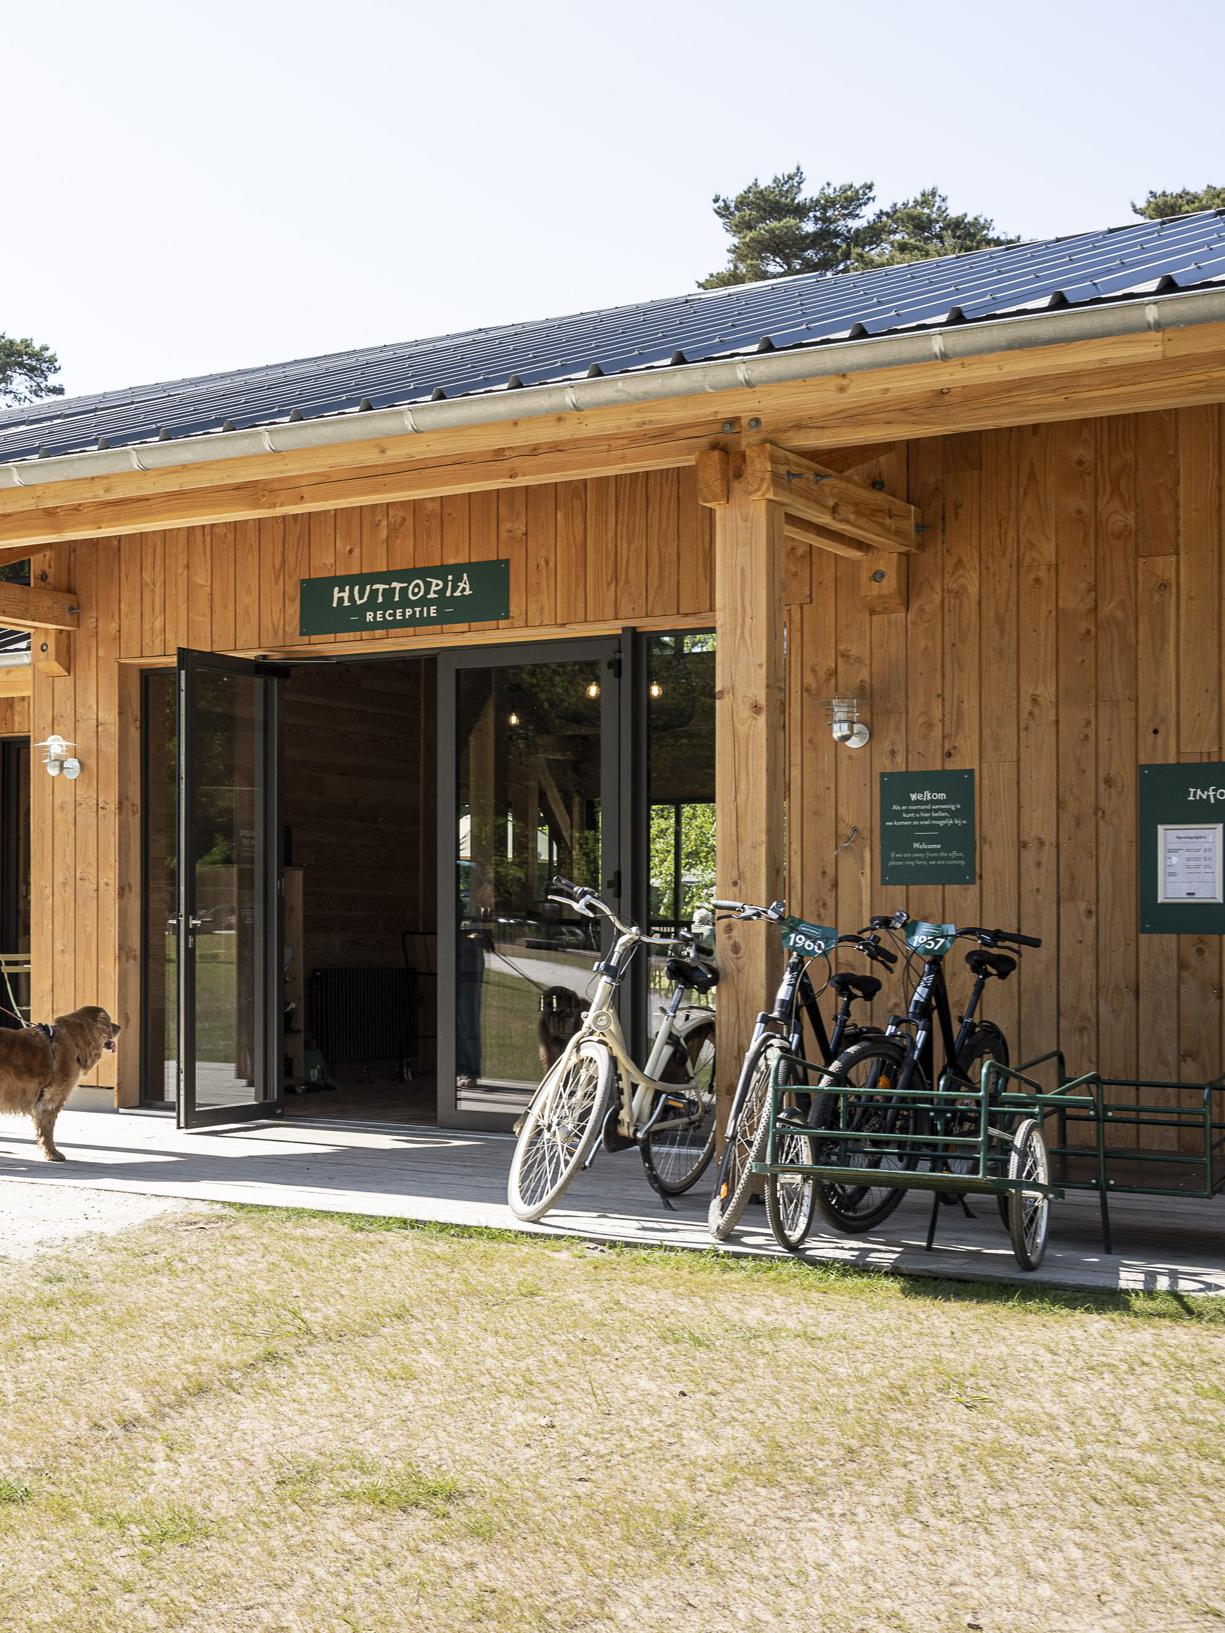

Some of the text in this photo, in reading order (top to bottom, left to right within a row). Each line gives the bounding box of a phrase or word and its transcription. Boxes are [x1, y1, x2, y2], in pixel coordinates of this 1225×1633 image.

[366, 606, 438, 622] RECEPTIE
[789, 933, 825, 953] 1960
[912, 935, 946, 950] 1957
